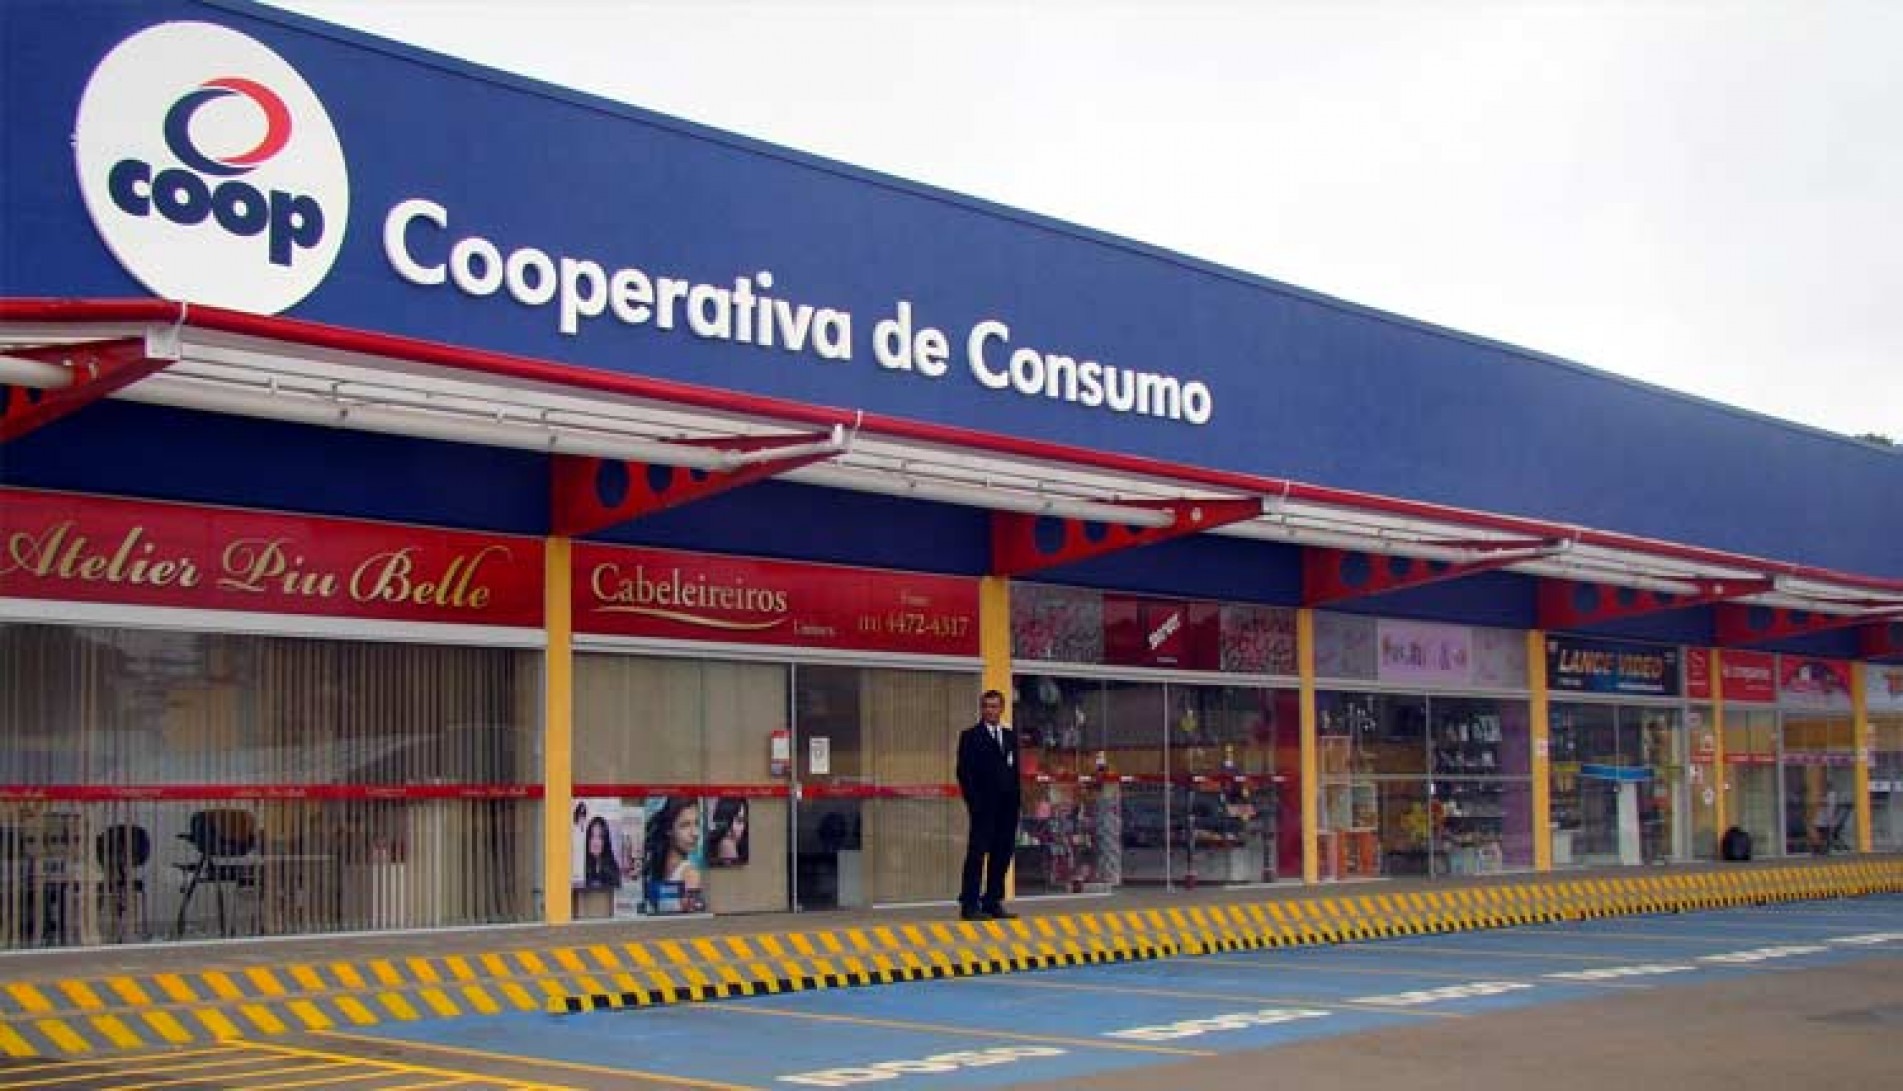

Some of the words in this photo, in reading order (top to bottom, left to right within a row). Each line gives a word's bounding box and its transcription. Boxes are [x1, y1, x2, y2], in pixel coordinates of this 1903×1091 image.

[108, 159, 325, 267] coop
[382, 197, 853, 361] Cooperativa
[872, 299, 949, 378] de
[967, 318, 1213, 425] Consumo
[0, 520, 201, 587] Atelier
[216, 538, 337, 597] Piu
[350, 545, 511, 609] Belle
[591, 562, 788, 613] Cabeleireiros
